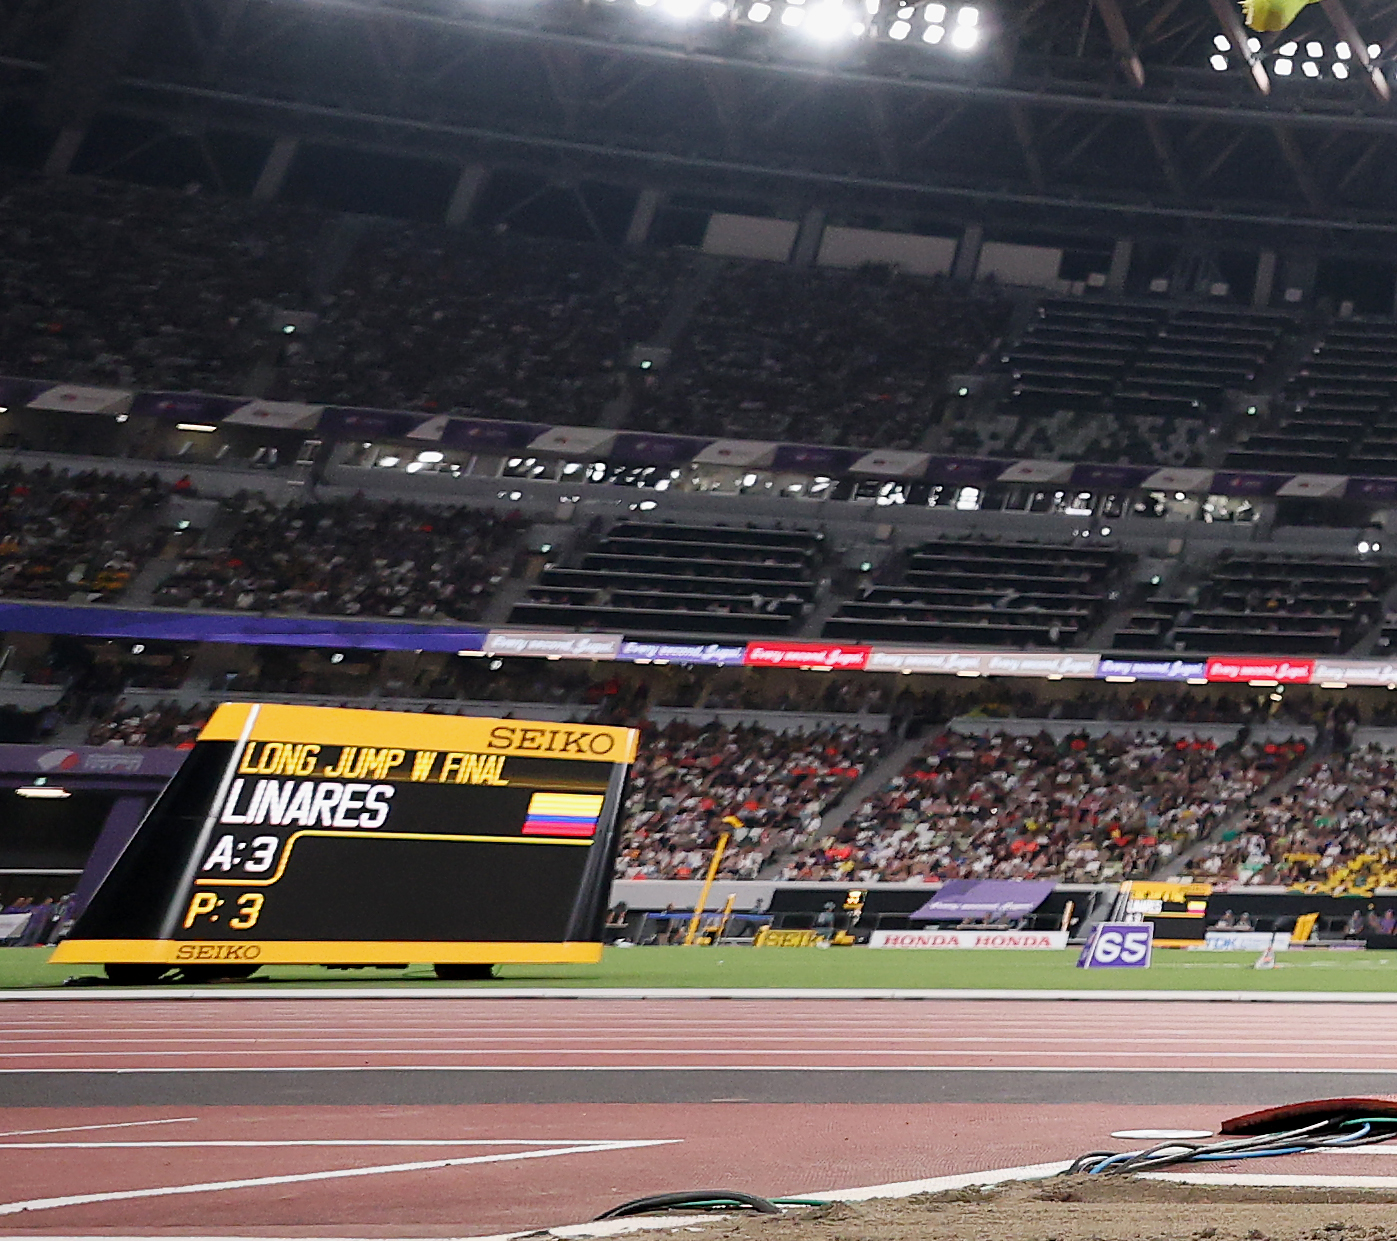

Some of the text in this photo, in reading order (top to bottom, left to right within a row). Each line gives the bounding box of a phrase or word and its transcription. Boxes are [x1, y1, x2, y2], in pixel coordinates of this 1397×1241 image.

[487, 726, 615, 755] SEIKO
[239, 741, 510, 786] LONG JUMP W FINAL
[221, 779, 395, 829] LINARES
[176, 945, 261, 960] SEIKO
[883, 935, 1052, 948] HONDA HONDA
[1094, 932, 1148, 963] 65
